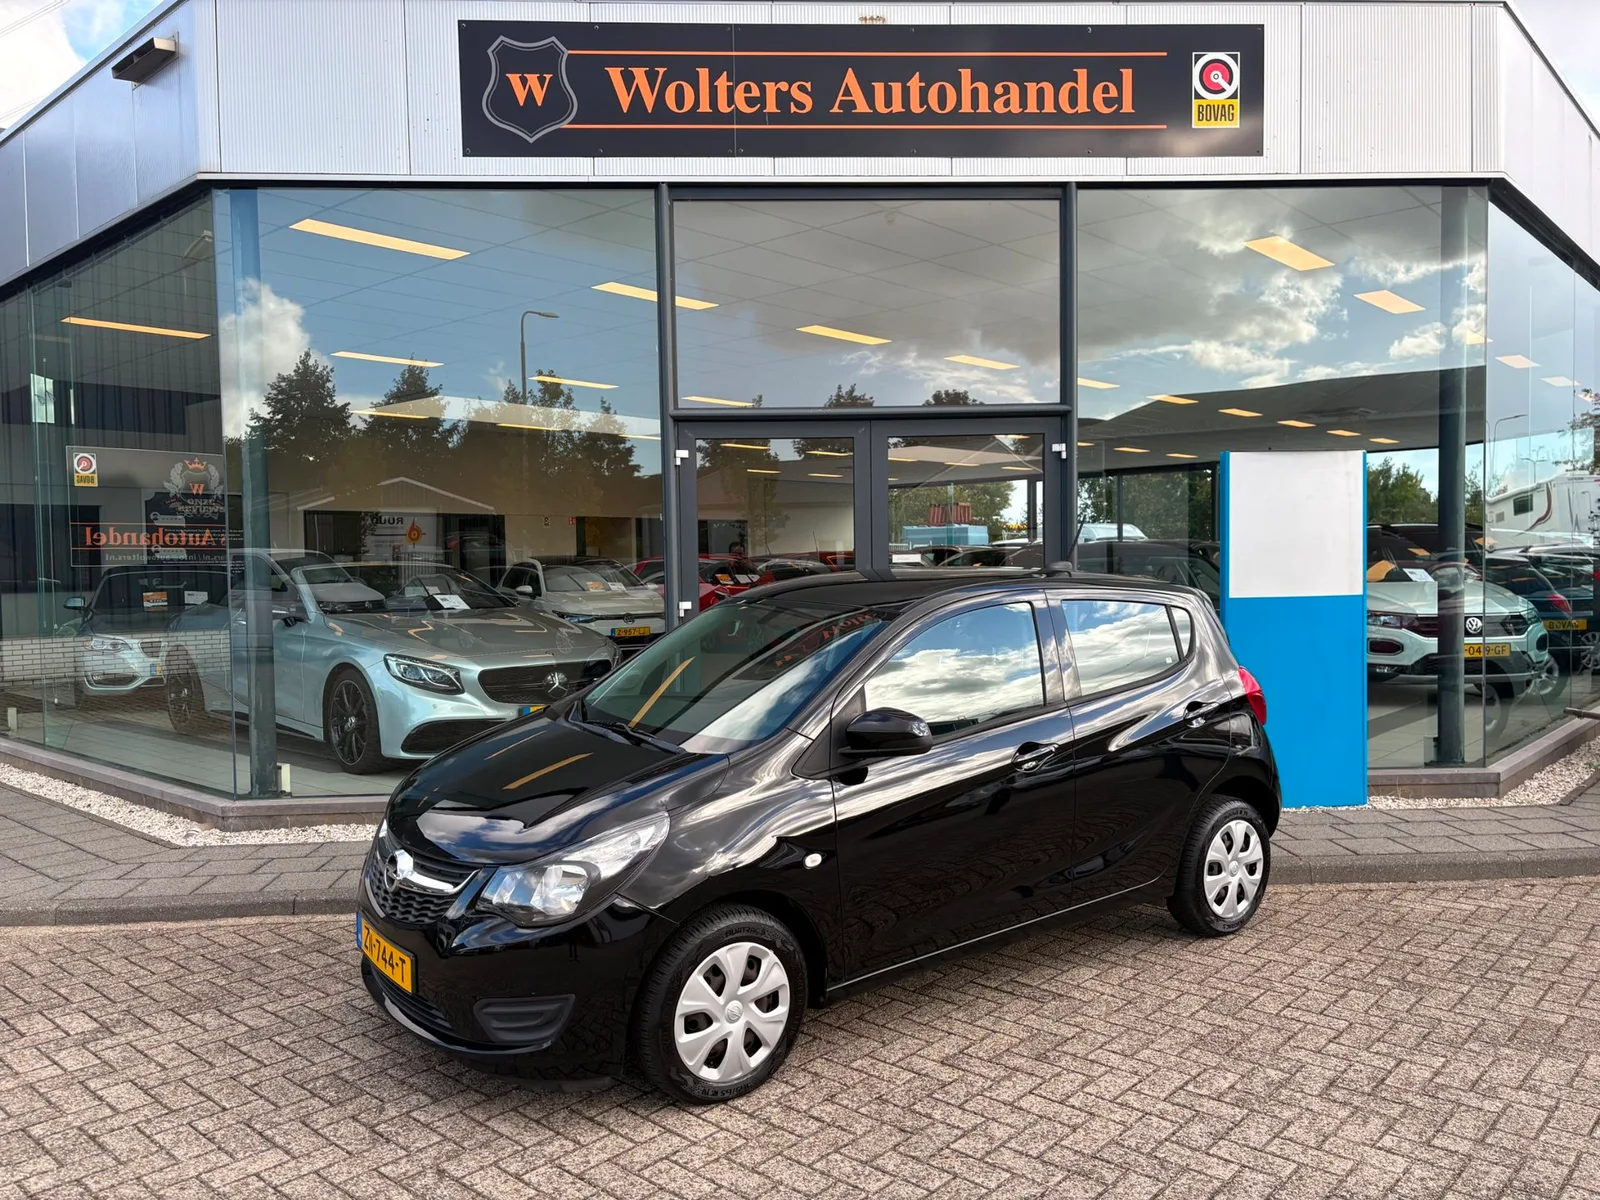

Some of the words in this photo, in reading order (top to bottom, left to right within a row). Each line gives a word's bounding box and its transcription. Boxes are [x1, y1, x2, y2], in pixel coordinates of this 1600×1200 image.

[505, 73, 554, 107] W
[604, 66, 814, 114] Wolters
[829, 66, 1136, 115] Autohandel
[1197, 103, 1235, 122] BOVAG
[1464, 645, 1507, 656] -049-GF
